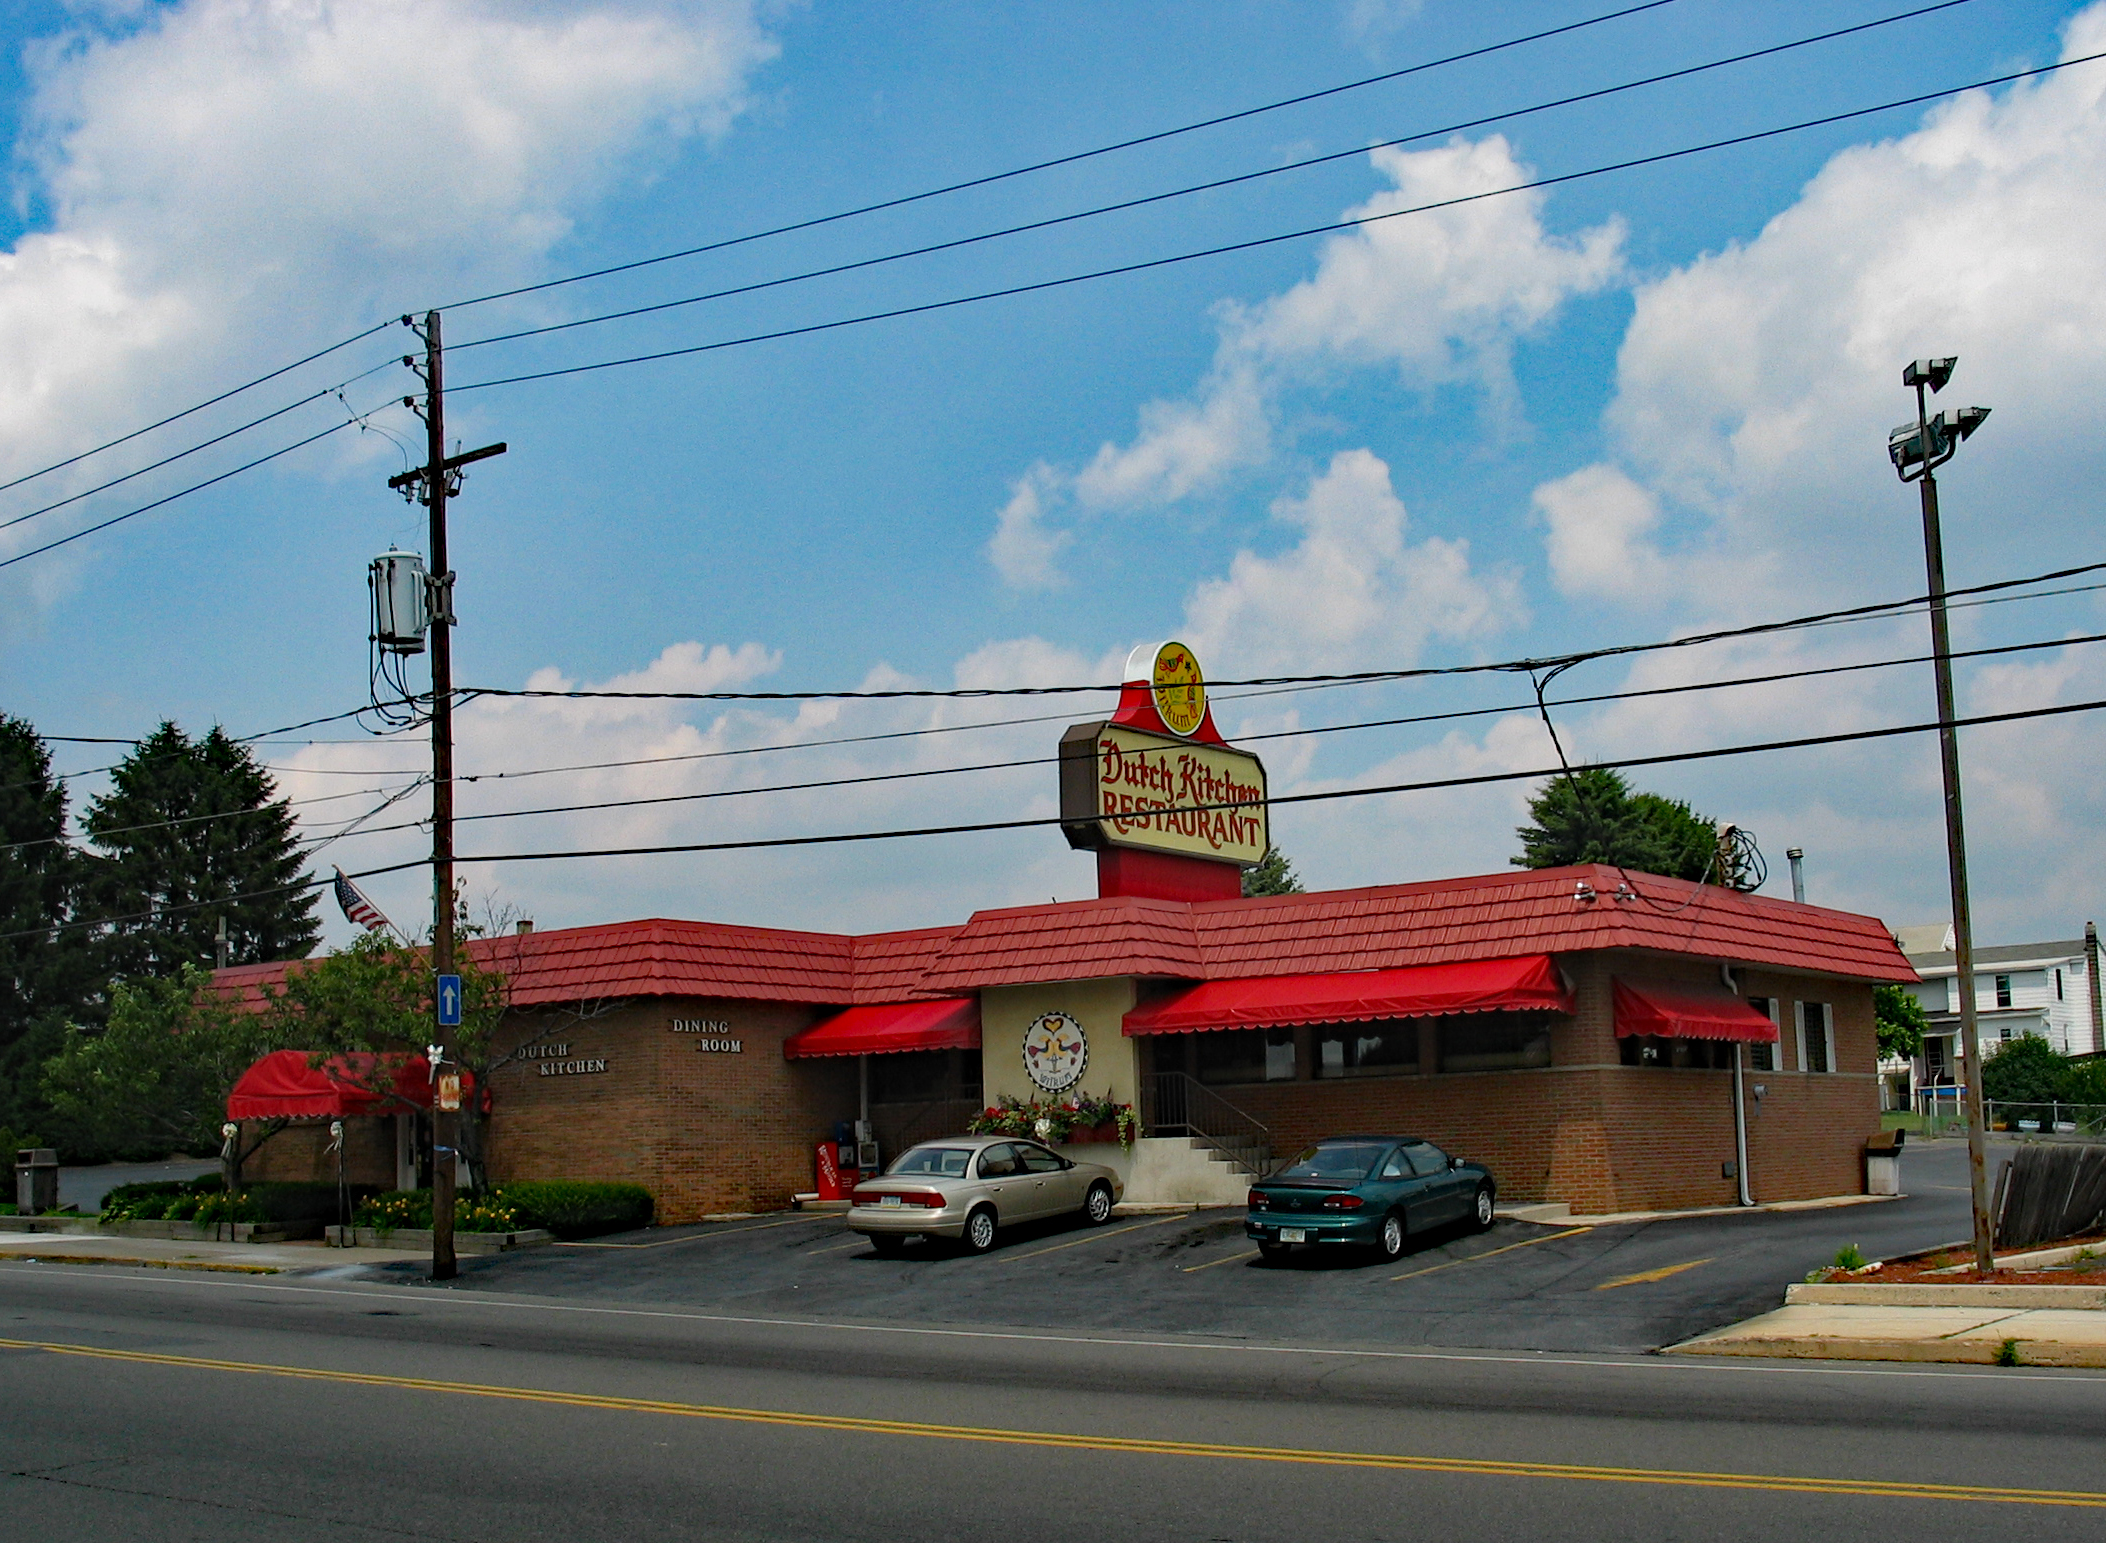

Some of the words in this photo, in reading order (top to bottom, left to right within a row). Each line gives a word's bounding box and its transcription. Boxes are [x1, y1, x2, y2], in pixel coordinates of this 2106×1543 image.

[1100, 738, 1174, 803] Dutch
[1176, 753, 1261, 814] Kitchen
[1102, 790, 1261, 849] RESTAURANT
[673, 1018, 729, 1034] DINING
[517, 1043, 569, 1060] DUTCH
[701, 1038, 742, 1053] ROOM
[540, 1058, 606, 1076] KITCHEN
